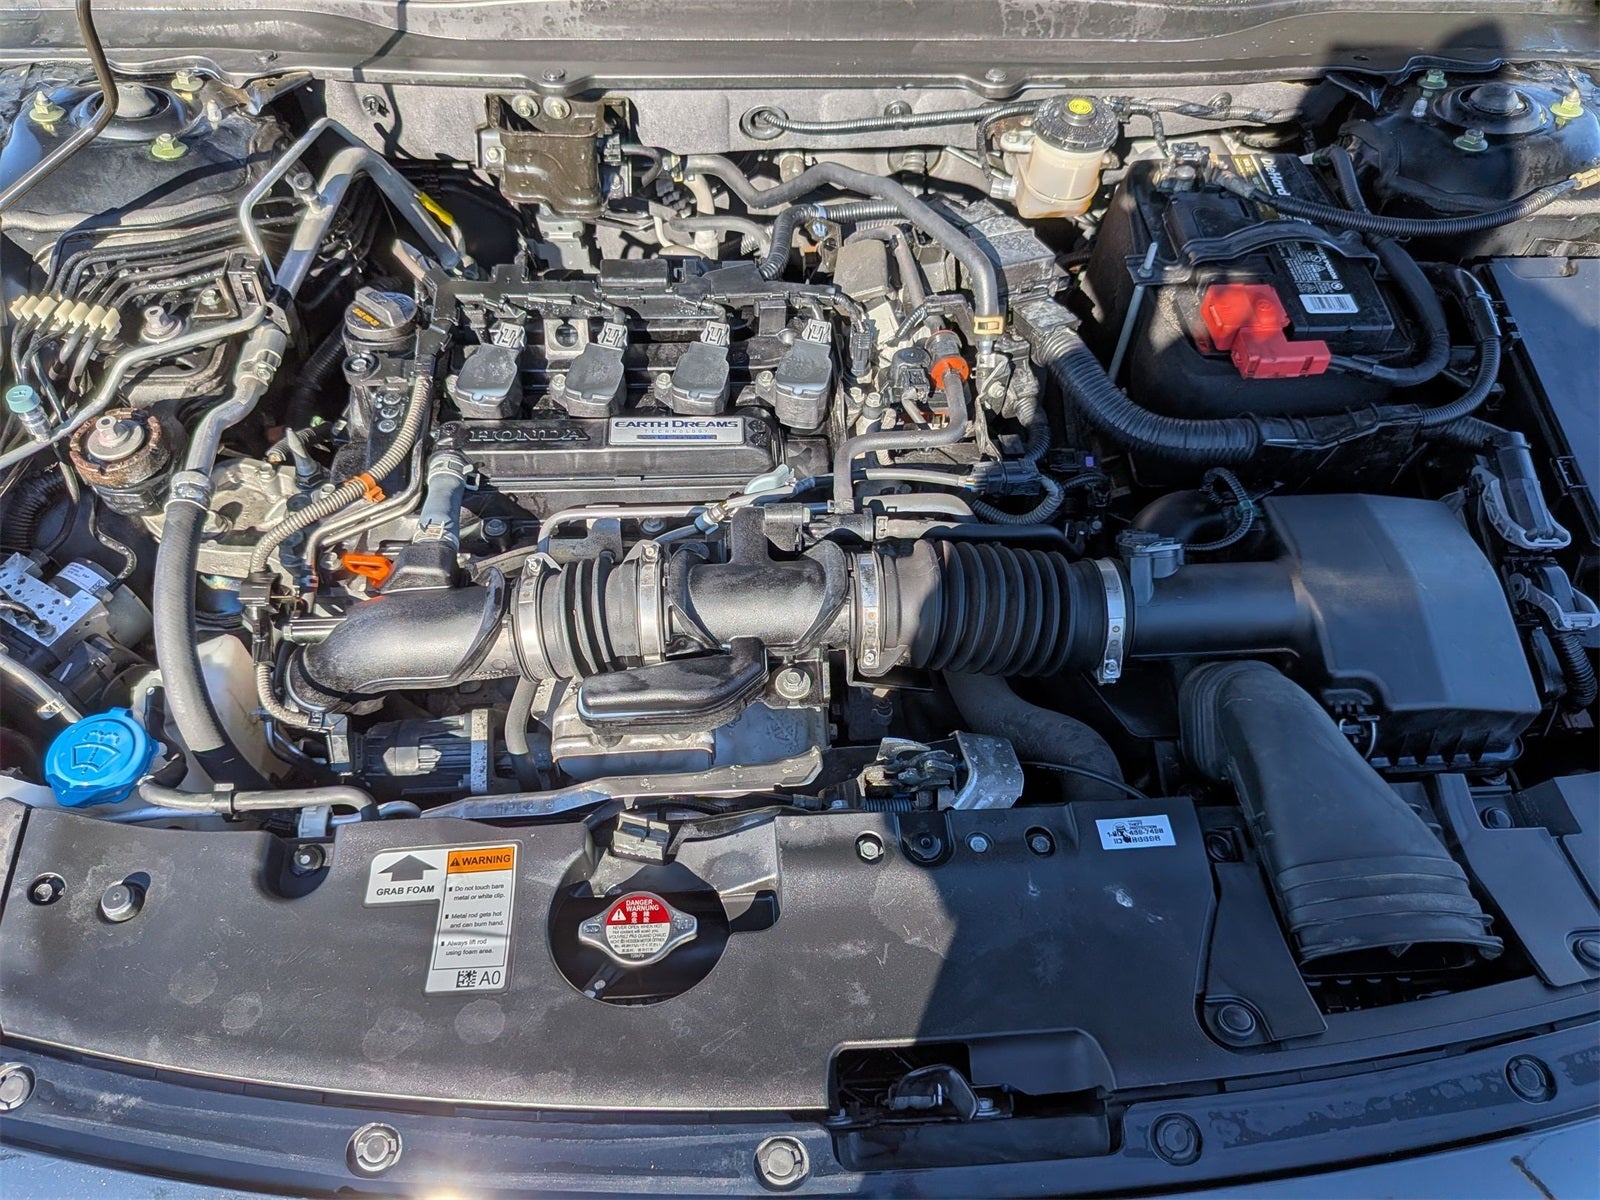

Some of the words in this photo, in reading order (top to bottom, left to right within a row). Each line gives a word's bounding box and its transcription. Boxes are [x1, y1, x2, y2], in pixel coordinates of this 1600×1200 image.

[1260, 157, 1291, 196] DieHard
[614, 420, 669, 428] EARTH
[672, 420, 738, 428] DREAMS
[469, 428, 591, 442] HONDA
[462, 854, 511, 866] WARNING
[376, 887, 404, 896] GRAB
[406, 885, 435, 895] FOAM
[479, 911, 492, 919] gets
